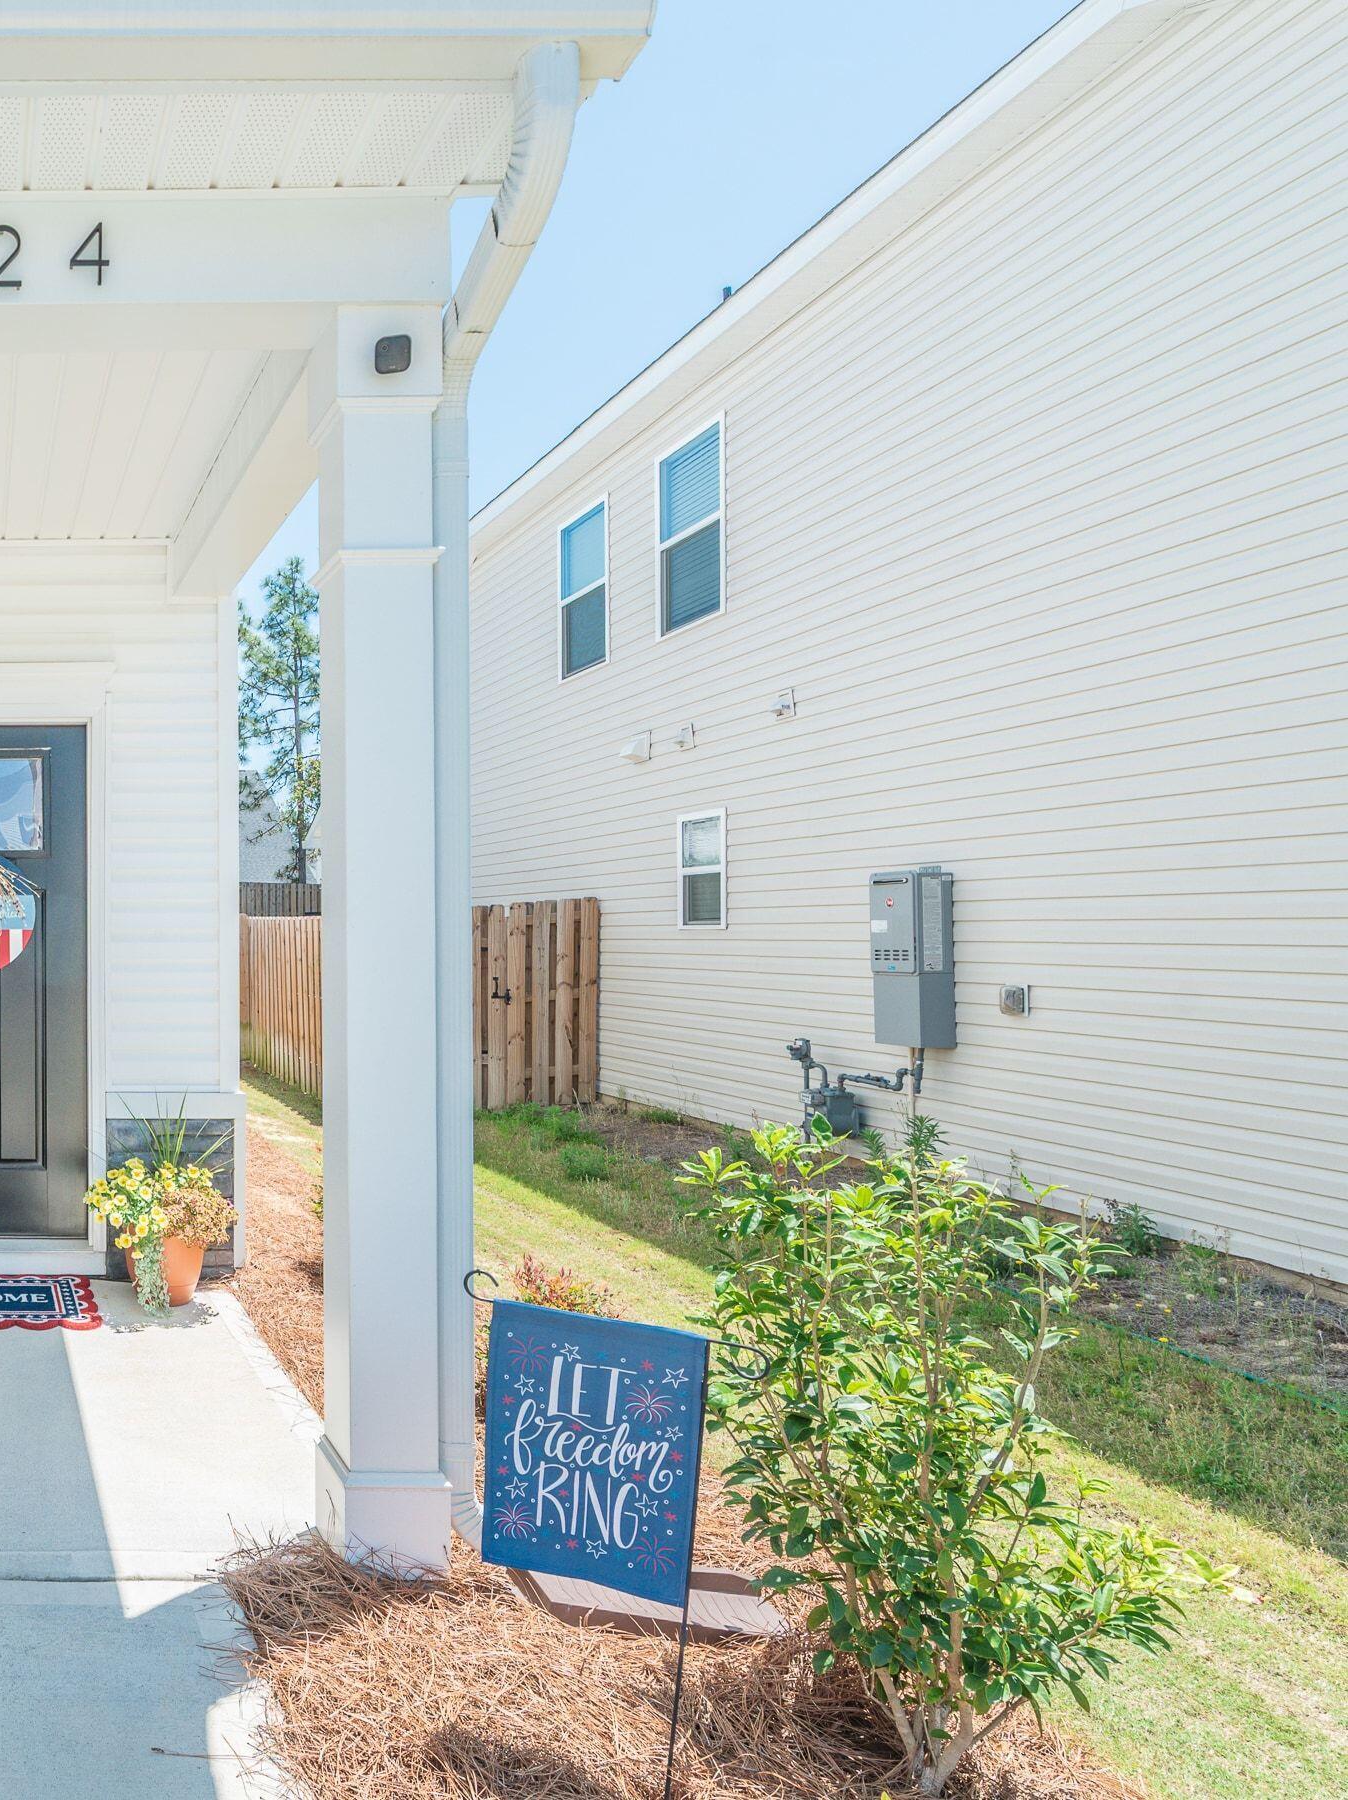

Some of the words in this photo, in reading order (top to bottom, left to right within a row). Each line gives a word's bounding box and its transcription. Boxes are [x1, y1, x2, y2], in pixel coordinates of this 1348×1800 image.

[547, 1355, 638, 1432] LET
[504, 1398, 674, 1493] freedom
[532, 1461, 640, 1549] RING
